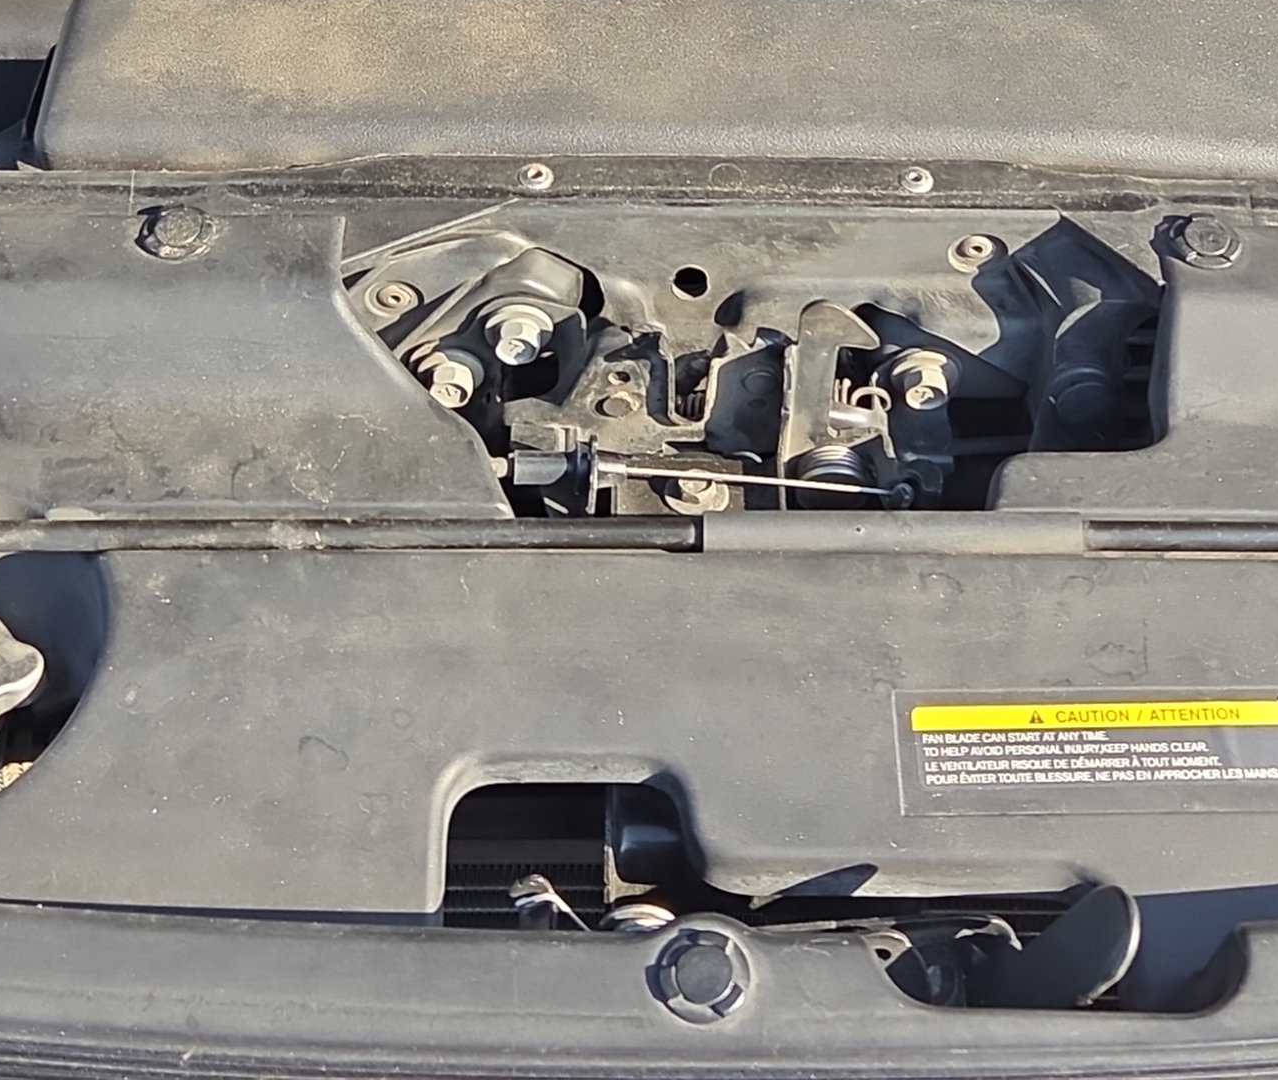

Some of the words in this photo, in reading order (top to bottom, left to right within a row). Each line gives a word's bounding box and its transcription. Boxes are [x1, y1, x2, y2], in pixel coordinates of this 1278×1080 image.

[1055, 709, 1130, 723] CAUTION
[1149, 707, 1241, 722] ATTENTION
[922, 732, 944, 744] FAN
[945, 732, 981, 744] BLADE
[982, 731, 1006, 743] CAN
[1007, 731, 1040, 743] START
[1042, 731, 1056, 742] AT
[1057, 730, 1080, 741] ANY
[1082, 730, 1110, 741] TIME.
[923, 746, 939, 757] TO
[941, 746, 969, 757] HELP
[970, 745, 1004, 756] AVOID
[1005, 744, 1063, 755] PERSONAL
[1130, 742, 1169, 753] HANDS
[1170, 741, 1209, 752] CLEAR.
[924, 761, 940, 772] LE
[940, 760, 1010, 771] VENTILATEUR
[1011, 759, 1053, 770] RISQUE
[1053, 759, 1070, 769] DE
[1071, 755, 1131, 769] DÉMARRER
[1131, 754, 1141, 768] À
[1141, 756, 1170, 768] TOUT
[1171, 755, 1222, 767] MOMENT.
[926, 774, 959, 785] POUR
[959, 771, 997, 784] ÉVITER
[998, 772, 1033, 783] TOUTE
[1034, 771, 1095, 782] BLESSURE,
[1095, 770, 1111, 781] NE
[1112, 770, 1135, 781] PAS
[1136, 769, 1152, 781] EN
[1153, 768, 1221, 780] APPROCHER
[1222, 768, 1244, 779] LES
